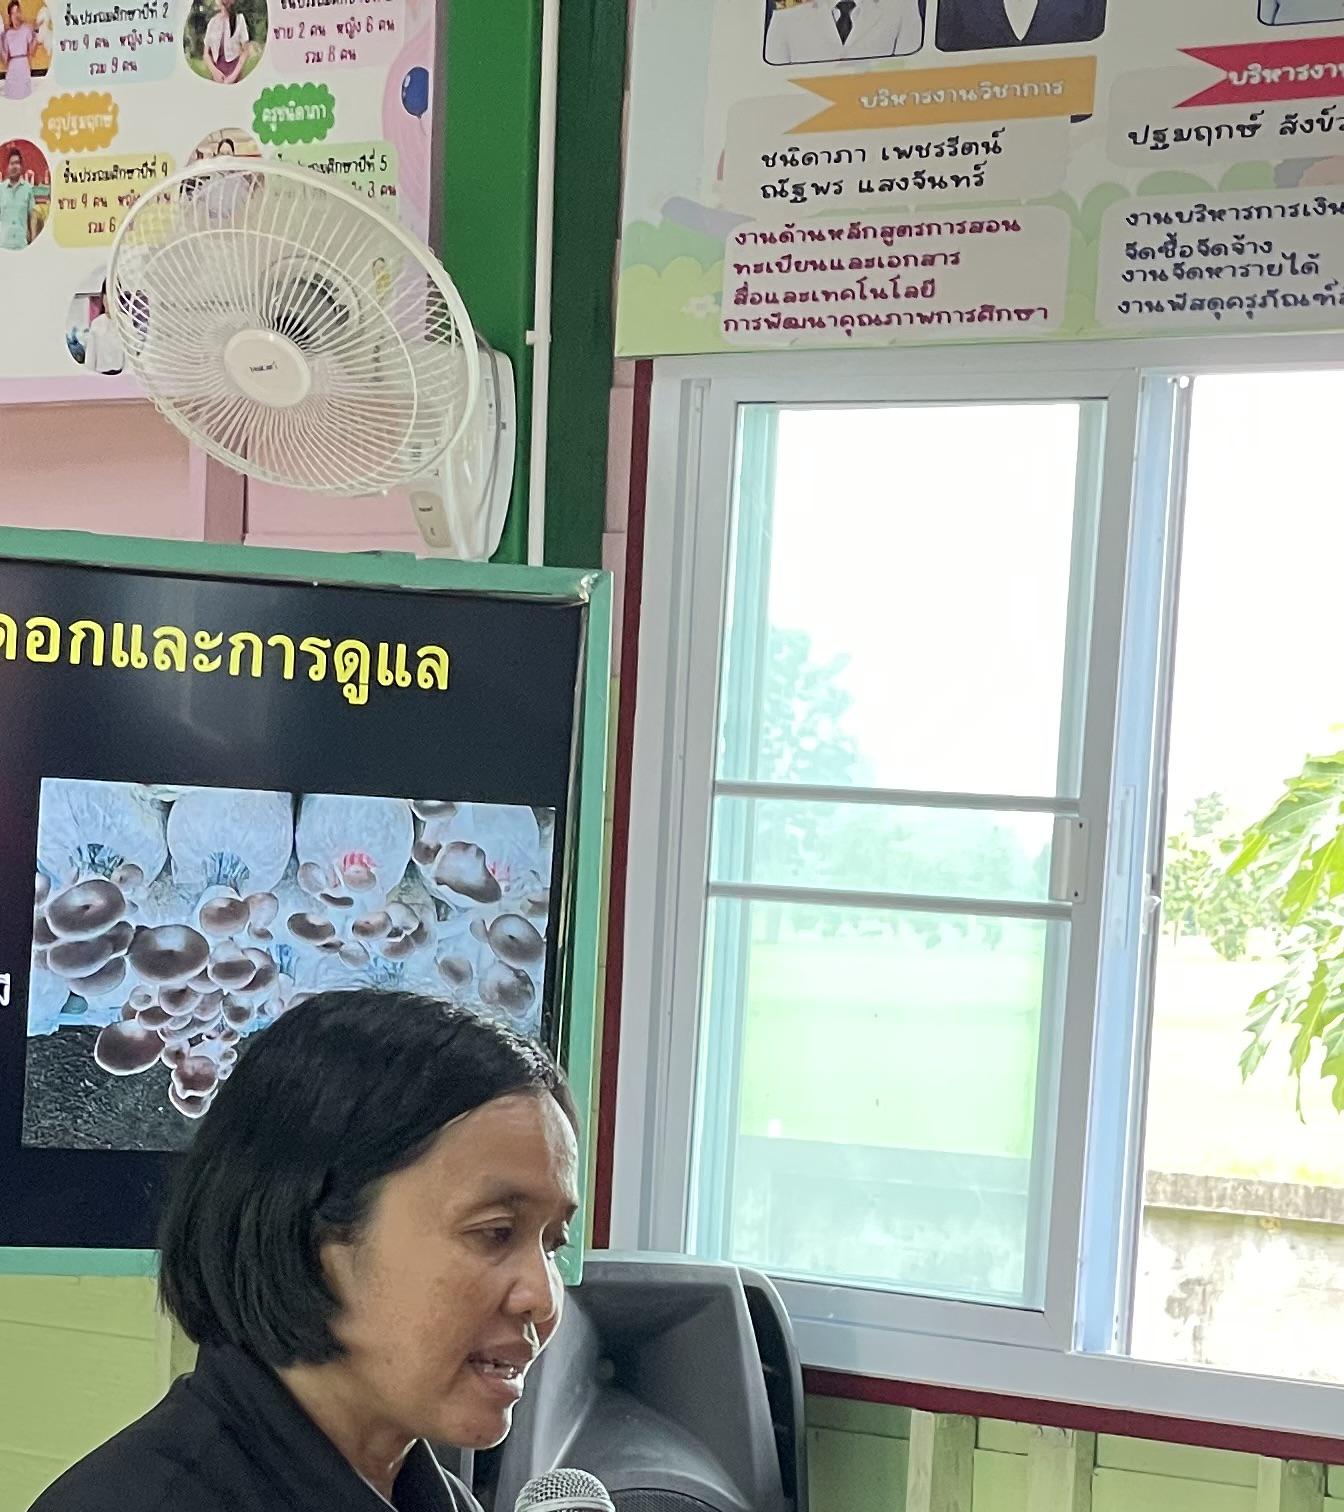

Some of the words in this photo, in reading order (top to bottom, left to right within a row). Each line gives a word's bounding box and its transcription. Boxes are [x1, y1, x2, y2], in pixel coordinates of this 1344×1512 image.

[860, 80, 1063, 109] บริหารงานวิชาการ
[1127, 110, 1265, 150] ปฐมฤกษ์
[761, 147, 866, 167] ชนิดาภา
[881, 127, 1005, 161] เพชรรัตน์
[760, 178, 844, 203] ณัฐพร
[858, 161, 987, 194] แสงจันทร์
[735, 219, 1021, 246] งานด้านหลักสูตรการสอน
[1124, 233, 1273, 262] จัดซื้อจัดจ้าง
[733, 252, 960, 275] ทะเบียนและเอกสาร
[1121, 252, 1320, 282] งานจัดหารายได้
[733, 275, 935, 305] สื่อและเทคโนโลยี
[723, 304, 1048, 336] การพัฒนาคุณภาพการศึกษา
